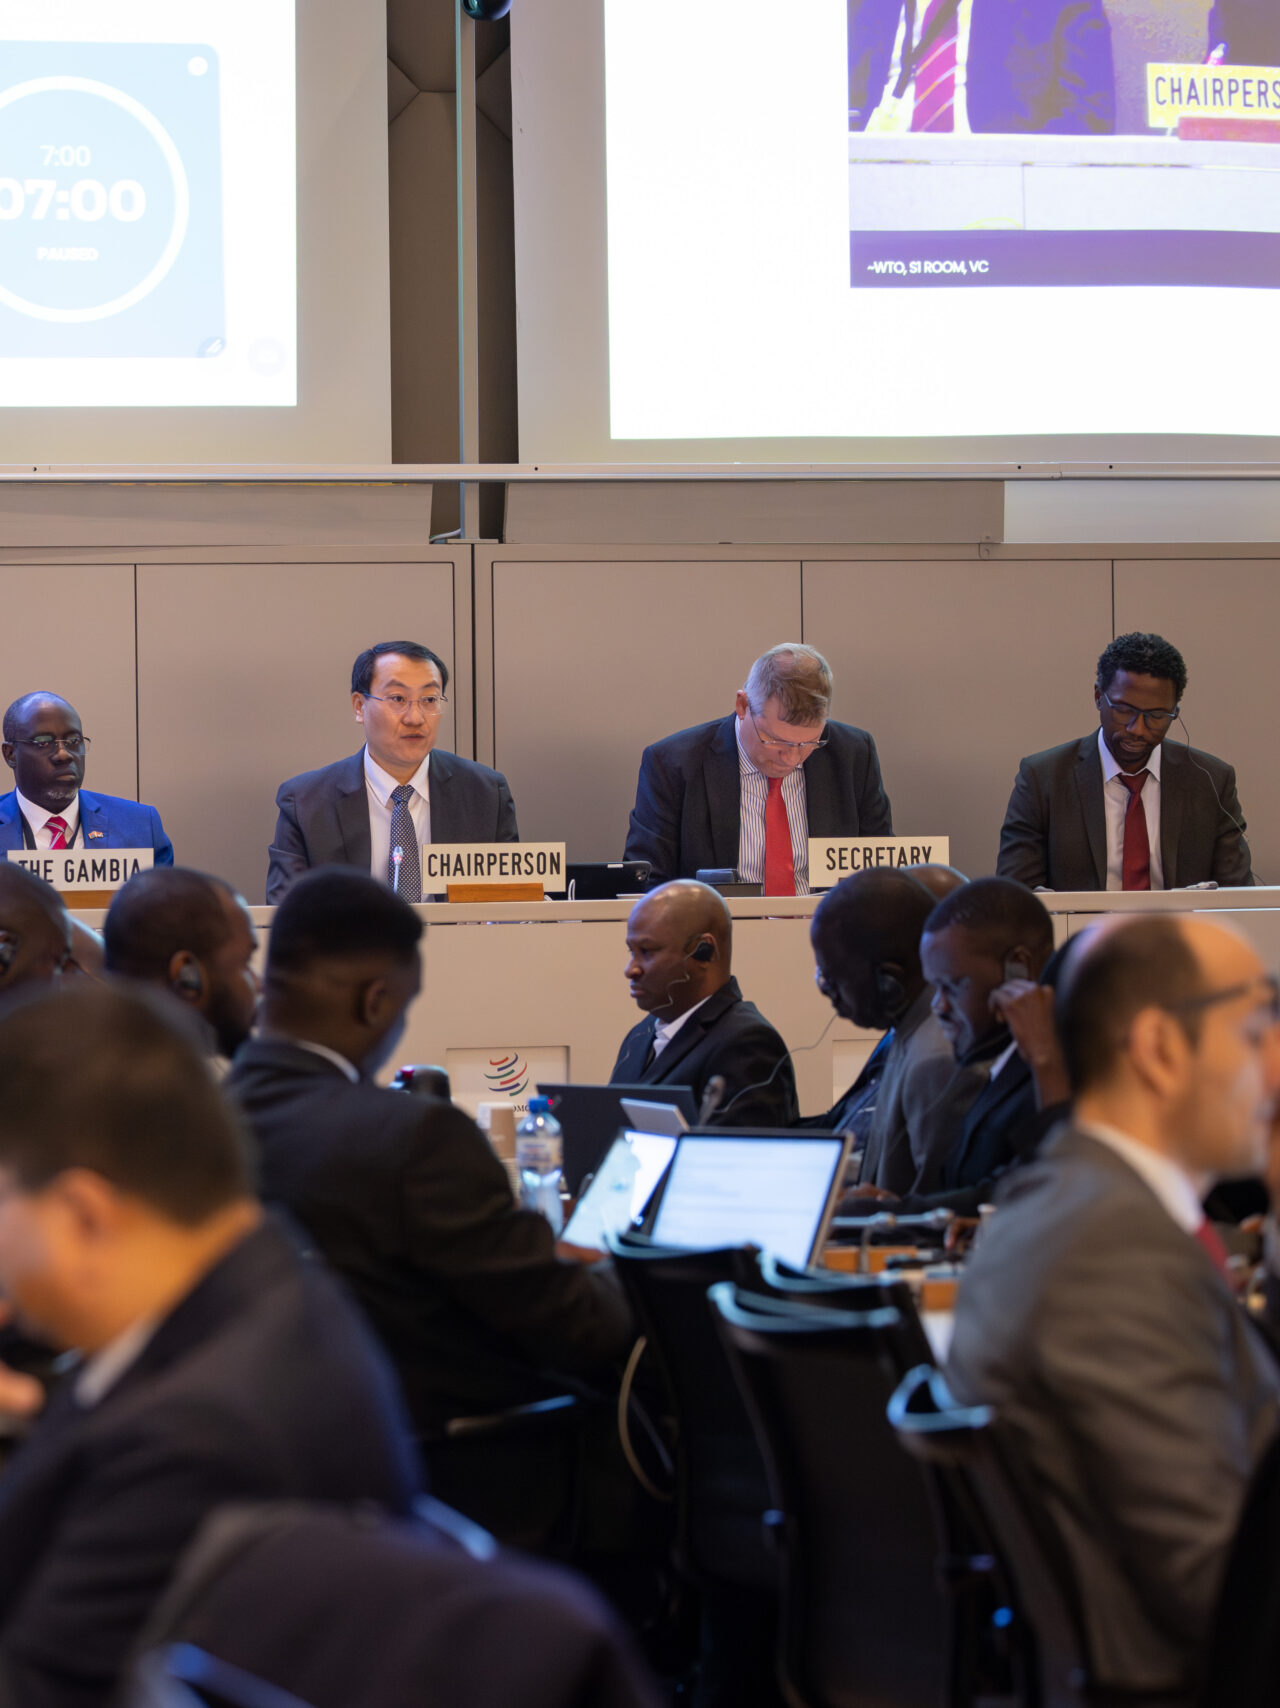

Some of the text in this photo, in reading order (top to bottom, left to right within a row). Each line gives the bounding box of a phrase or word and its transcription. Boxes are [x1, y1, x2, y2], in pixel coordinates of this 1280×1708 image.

[1154, 76, 1280, 109] CHAIRPERS
[39, 145, 92, 167] 7:00
[36, 247, 99, 261] PAUSED
[923, 260, 967, 275] ROOM,
[969, 259, 989, 273] VC
[427, 851, 561, 877] CHAIRPERSON
[825, 845, 932, 871] SECRETARY
